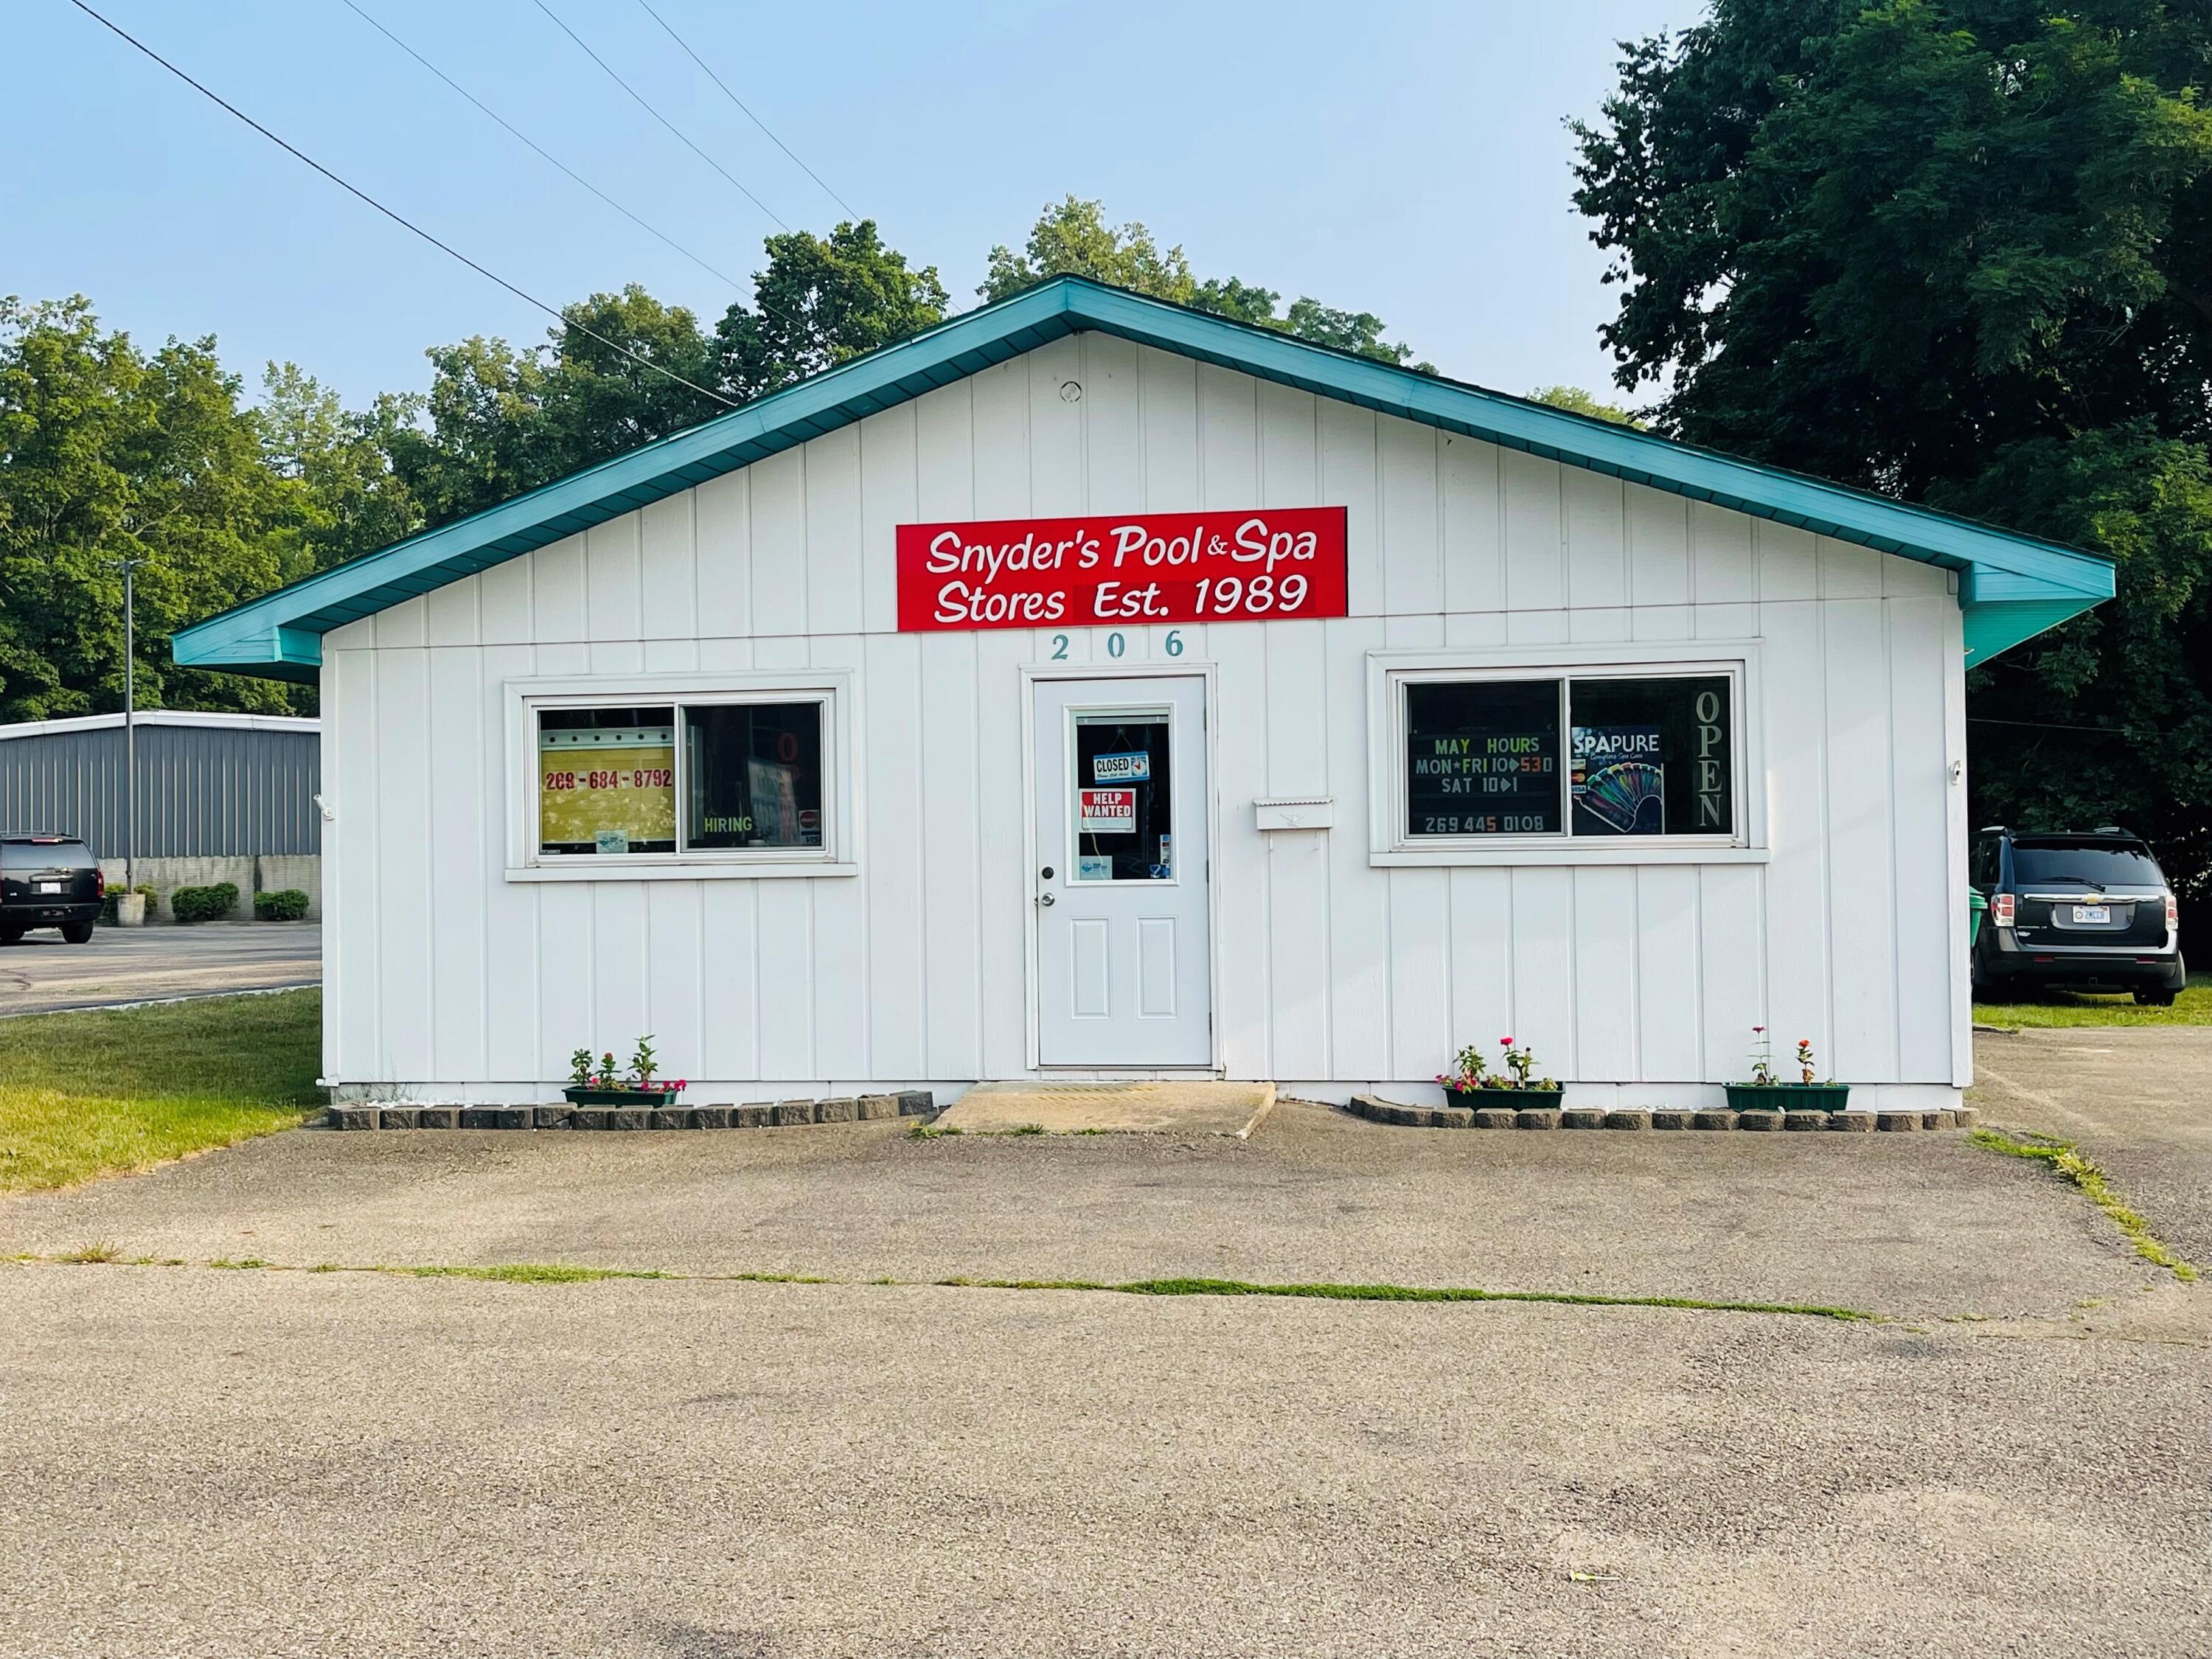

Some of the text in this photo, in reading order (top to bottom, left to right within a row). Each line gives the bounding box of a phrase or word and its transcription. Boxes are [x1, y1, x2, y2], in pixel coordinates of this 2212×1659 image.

[926, 518, 1318, 585] Snyder's Pool & Spa
[933, 574, 1308, 623] Stores Est. 1989
[1435, 737, 1540, 755] MAY HOURS
[1573, 734, 1660, 754] SPAPURE
[1096, 758, 1129, 773] CLOSED
[1697, 692, 1722, 827] OPEN
[1441, 776, 1518, 793] SAT 10 1
[1093, 793, 1122, 805] HELP
[1084, 804, 1131, 817] WANTED
[704, 816, 752, 832] HIRING
[1425, 815, 1544, 832] 269 445 0108
